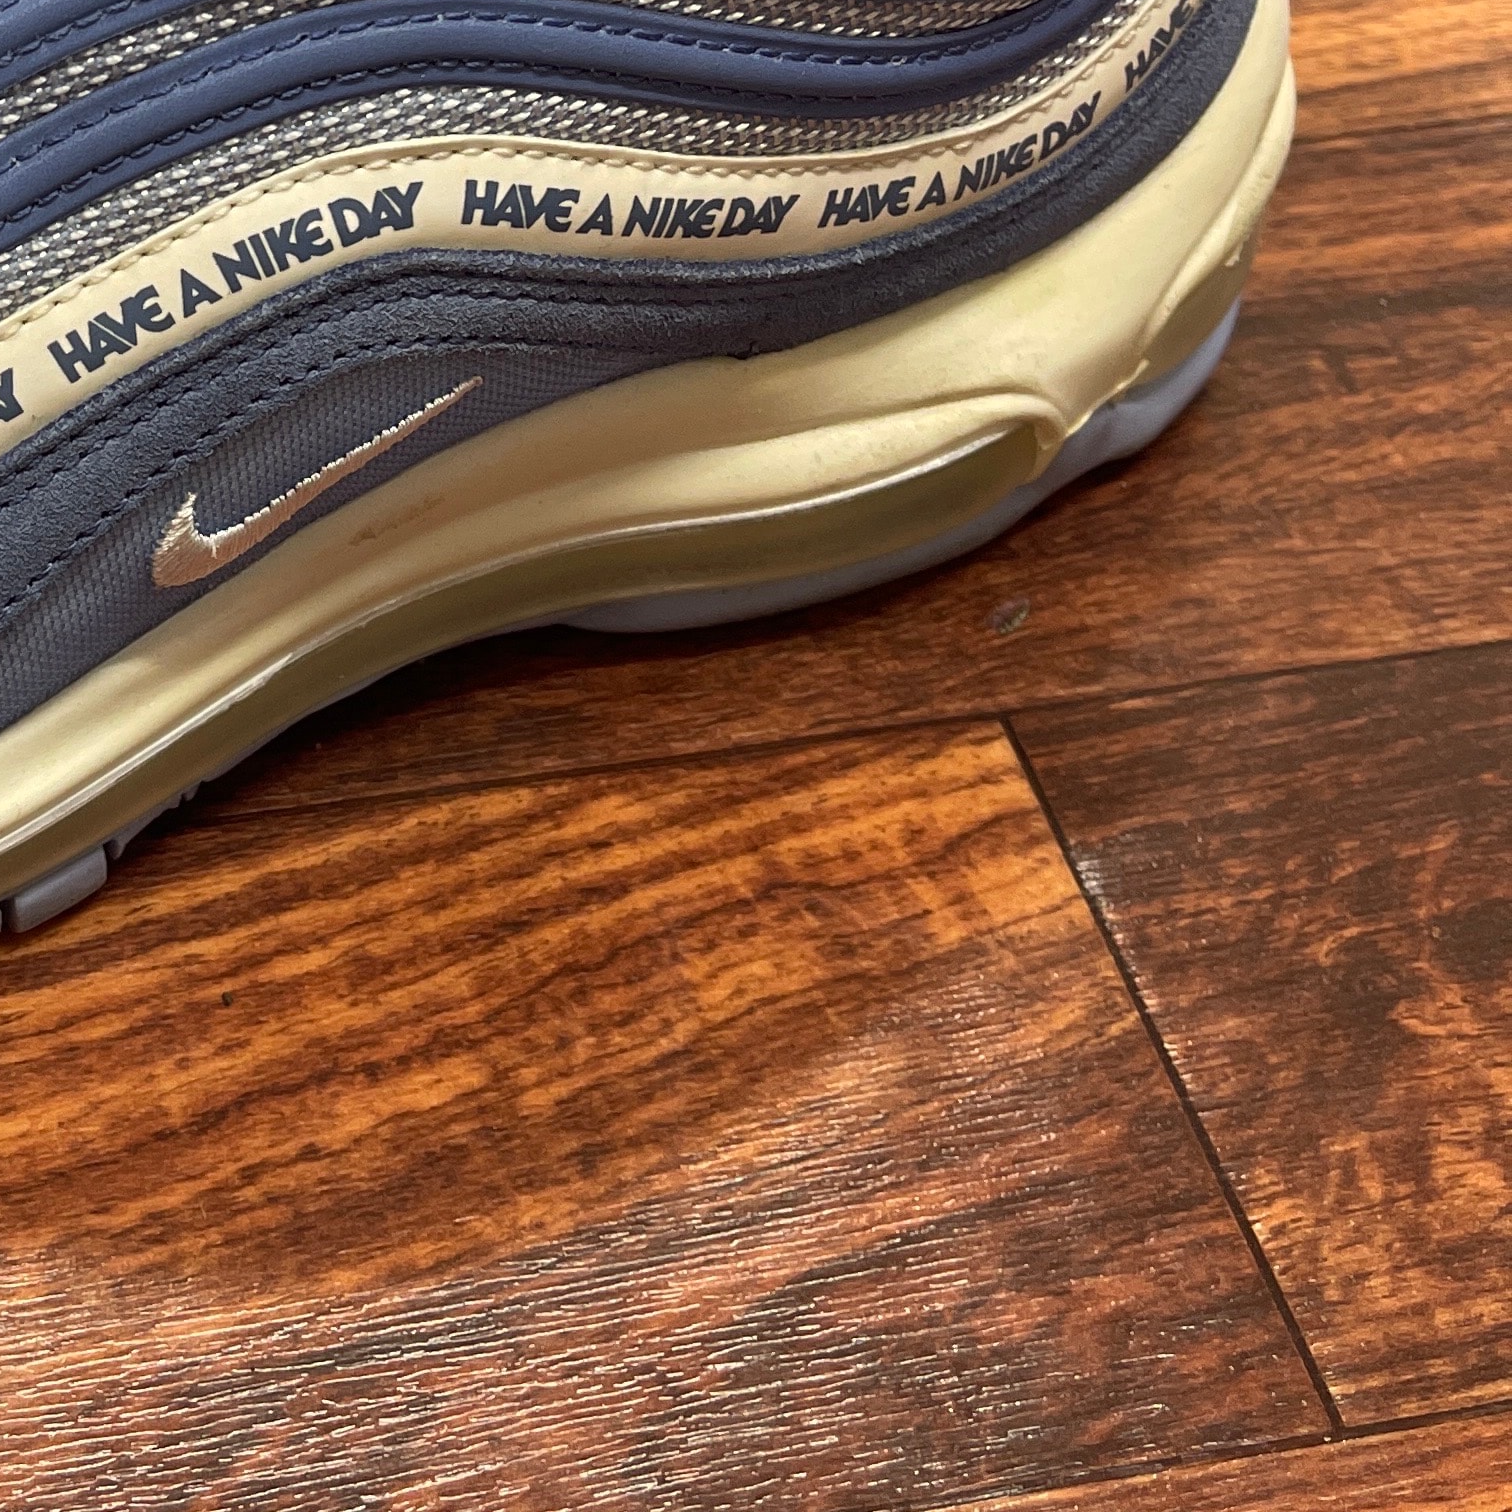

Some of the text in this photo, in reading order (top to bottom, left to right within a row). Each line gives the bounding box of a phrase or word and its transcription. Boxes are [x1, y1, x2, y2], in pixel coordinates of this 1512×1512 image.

[460, 178, 581, 233] HAVE
[575, 192, 614, 236] A
[817, 175, 916, 228] HAVE
[915, 171, 946, 212] A
[46, 284, 176, 384] HAVE
[180, 267, 223, 318] A
